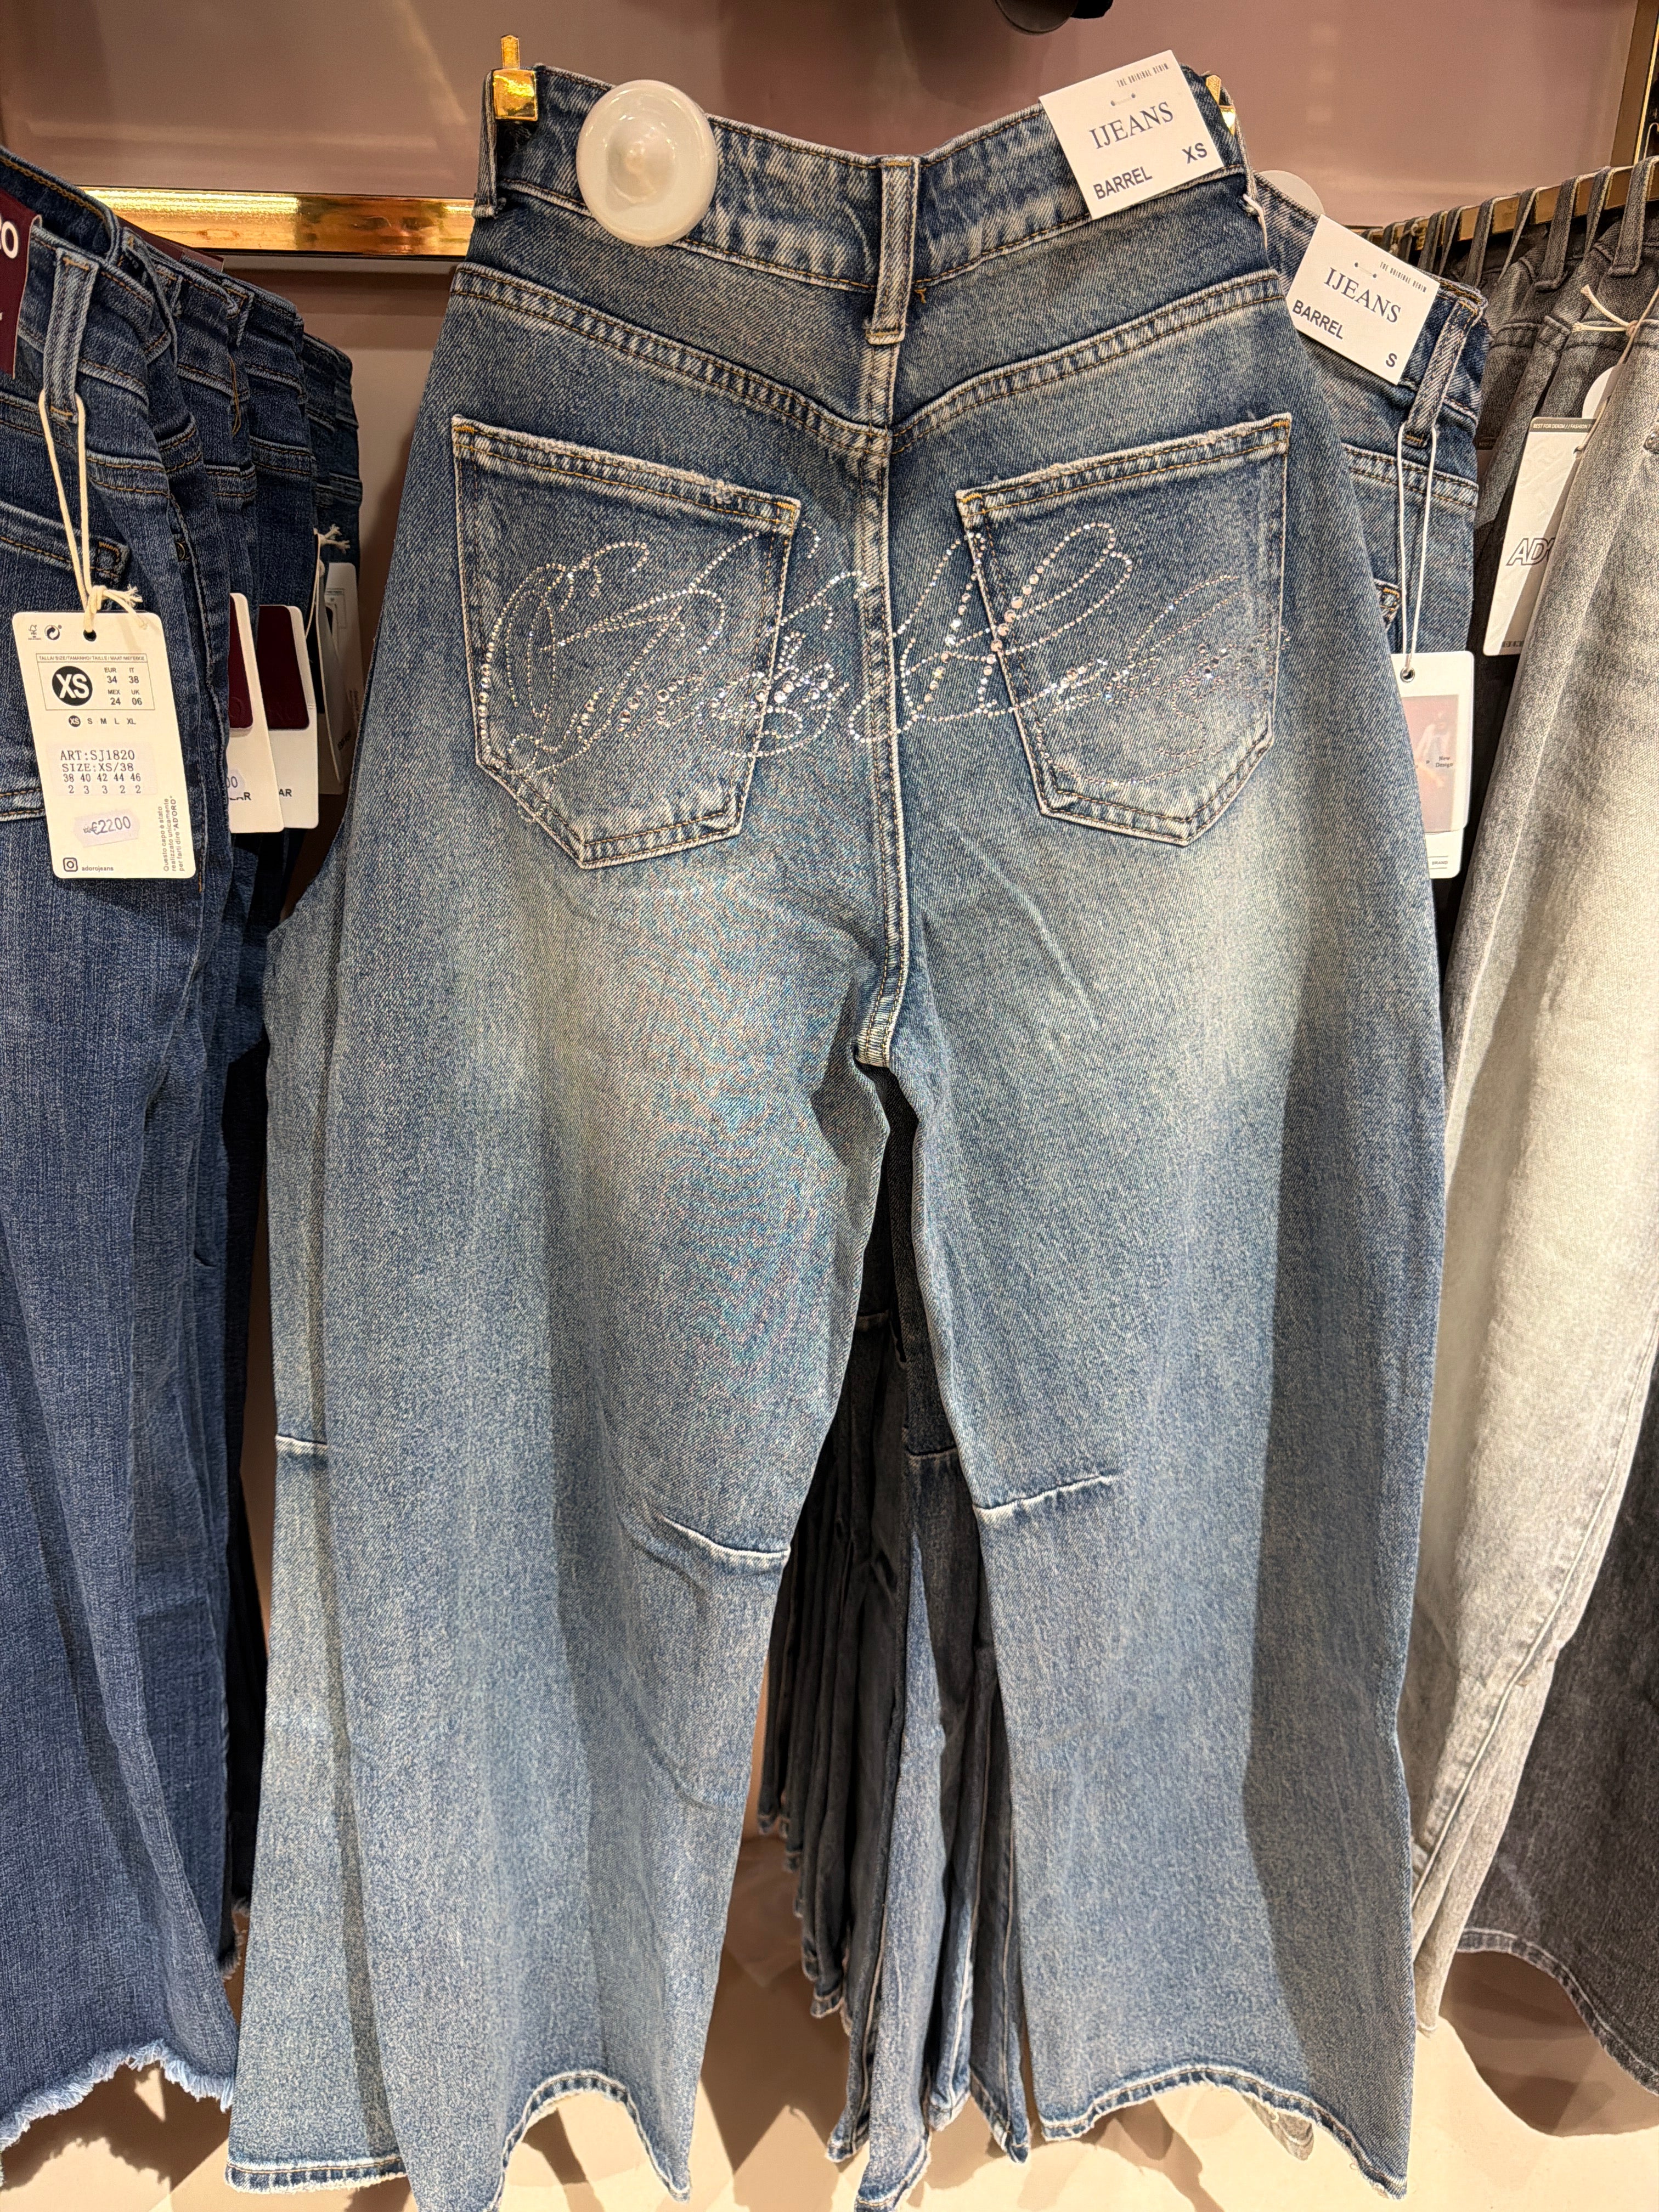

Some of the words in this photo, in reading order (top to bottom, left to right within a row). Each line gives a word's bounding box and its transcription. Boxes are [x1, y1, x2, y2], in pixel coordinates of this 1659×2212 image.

[1181, 142, 1207, 163] XS
[1093, 166, 1153, 200] BARREL
[1292, 300, 1344, 340] BARREL
[1385, 353, 1397, 367] S
[56, 673, 89, 699] XS
[107, 675, 117, 684] 34
[128, 675, 139, 684] 38
[110, 697, 121, 706] 24
[132, 697, 143, 706] 06
[60, 749, 135, 762] ART:SJ1820
[62, 762, 134, 772] SIZE:XS/38
[63, 774, 75, 782] 38
[81, 773, 91, 782] 40
[97, 773, 108, 782] 42
[114, 773, 125, 782] 44
[130, 772, 141, 782] 46
[68, 785, 75, 794] 2
[83, 785, 89, 794] 3
[101, 785, 108, 794] 3
[120, 785, 126, 794] 2
[135, 785, 141, 794] 2
[164, 798, 173, 838] unicamente
[168, 839, 177, 872] realizzato
